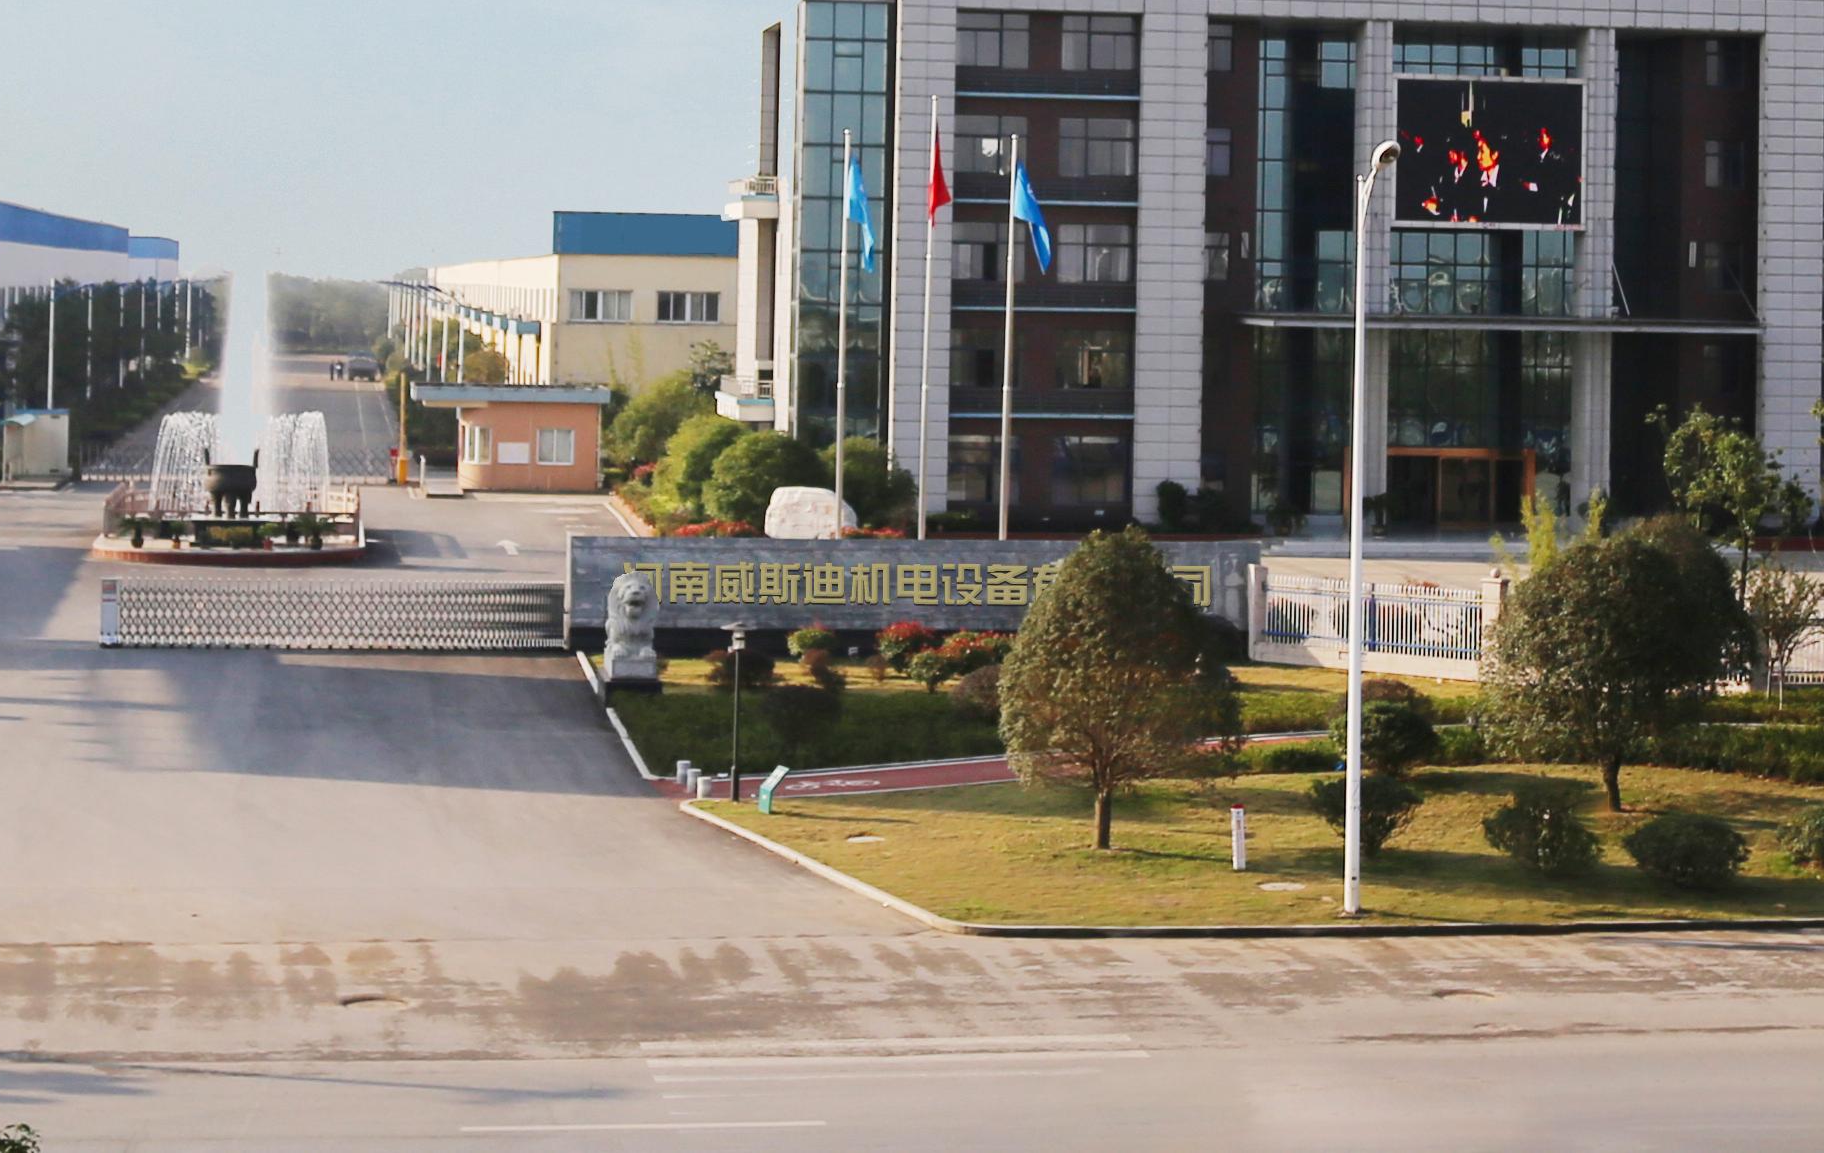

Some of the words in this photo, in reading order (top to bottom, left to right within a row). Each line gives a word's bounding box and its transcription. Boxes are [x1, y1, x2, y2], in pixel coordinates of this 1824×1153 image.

[623, 561, 1211, 606] 南威斯迪机电设备司
